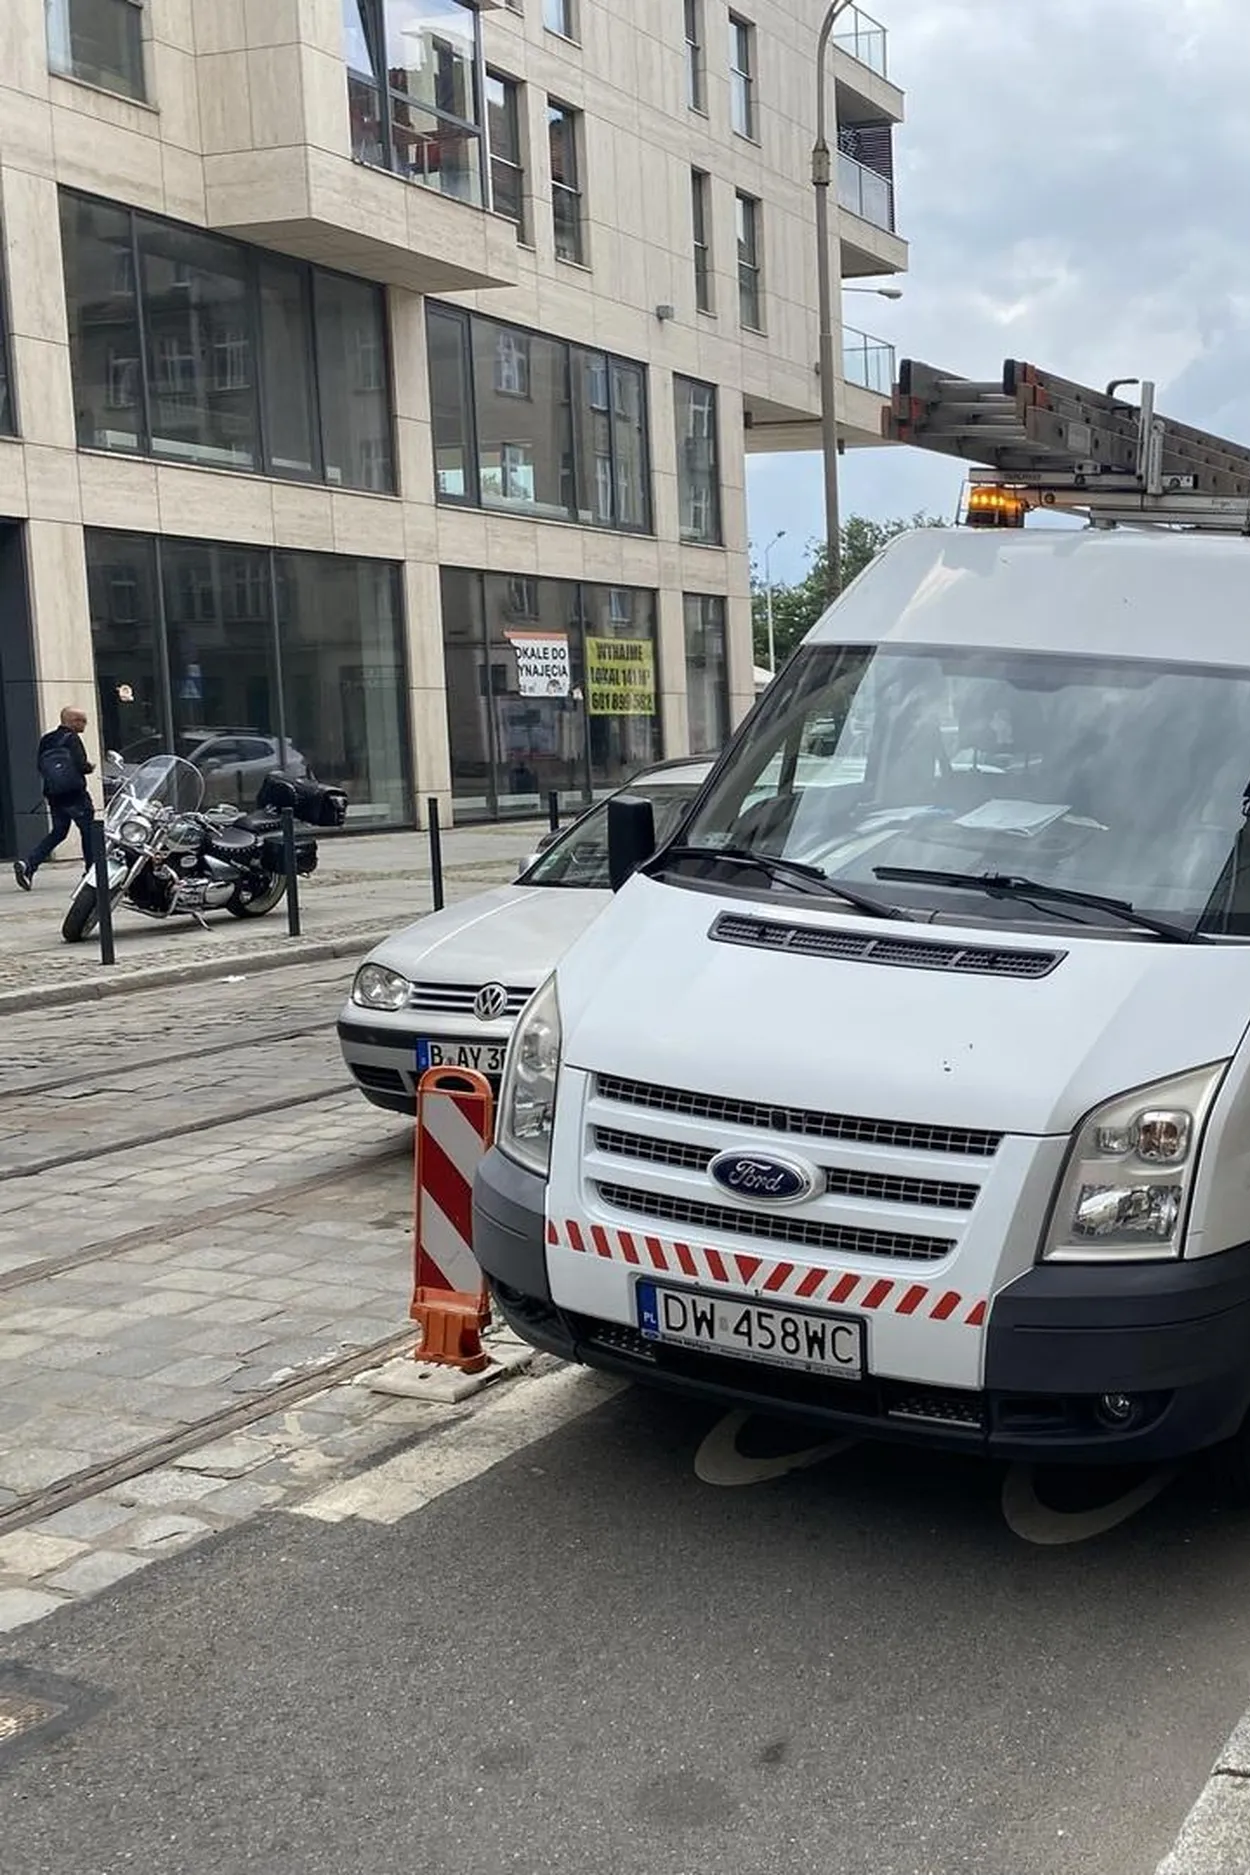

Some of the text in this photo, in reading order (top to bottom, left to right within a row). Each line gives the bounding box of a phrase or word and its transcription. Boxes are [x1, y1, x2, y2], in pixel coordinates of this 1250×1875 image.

[551, 648, 567, 660] DO
[430, 1044, 443, 1066] B
[457, 1045, 483, 1069] AY
[728, 1160, 785, 1192] Ford
[643, 1311, 657, 1324] PL
[663, 1292, 854, 1364] DW 458WC
